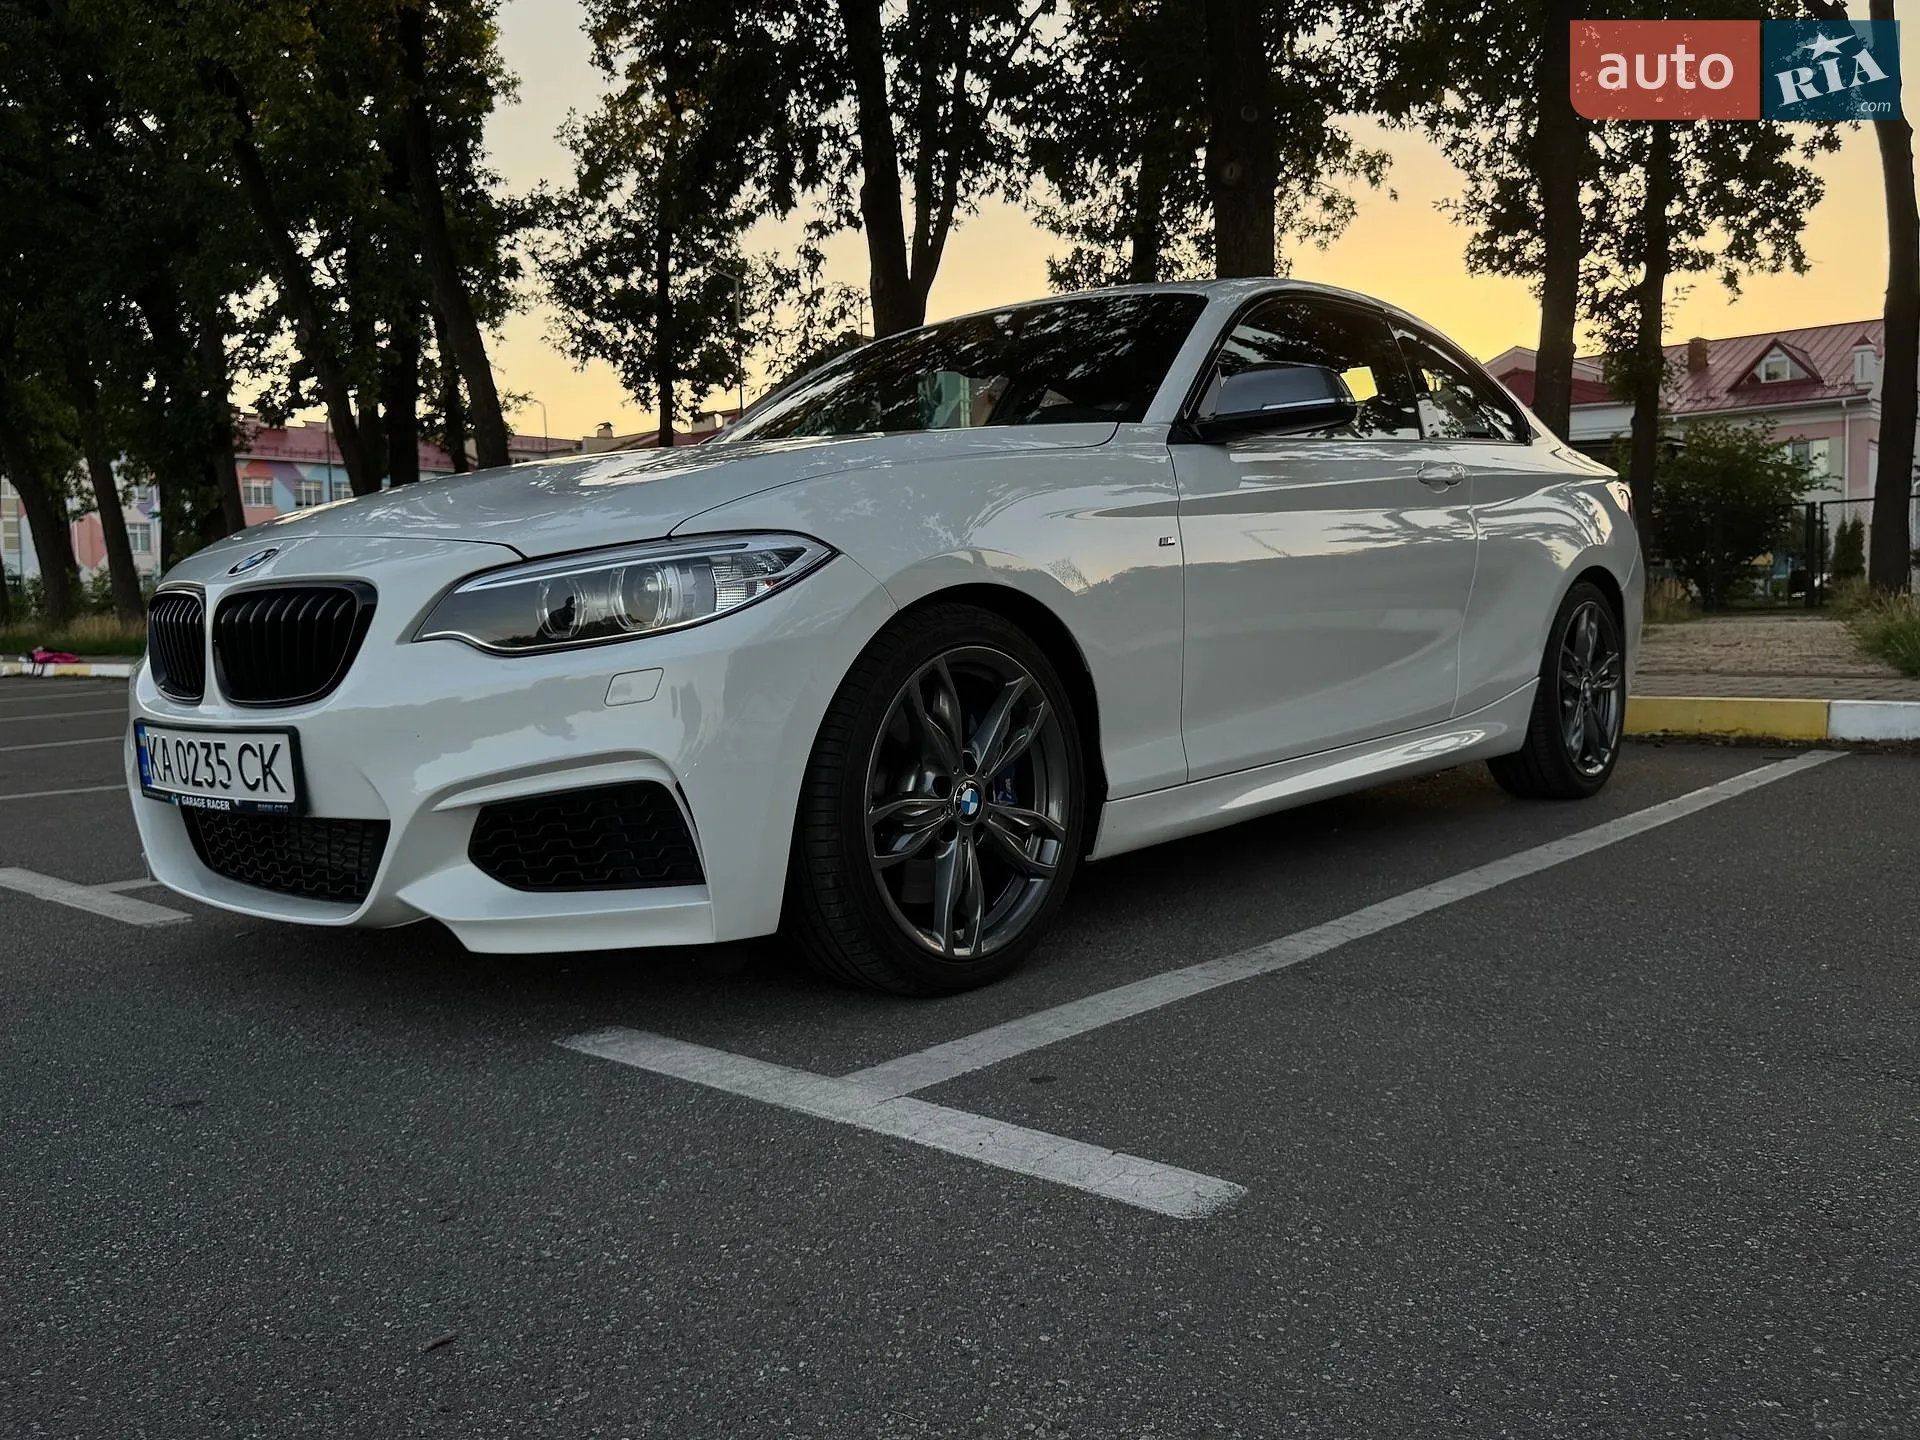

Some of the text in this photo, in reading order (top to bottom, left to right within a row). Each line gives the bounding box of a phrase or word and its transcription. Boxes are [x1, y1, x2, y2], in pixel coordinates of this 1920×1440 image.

[146, 735, 287, 793] KA 0235 CK
[181, 795, 206, 808] GARAGE
[206, 799, 230, 811] RACER
